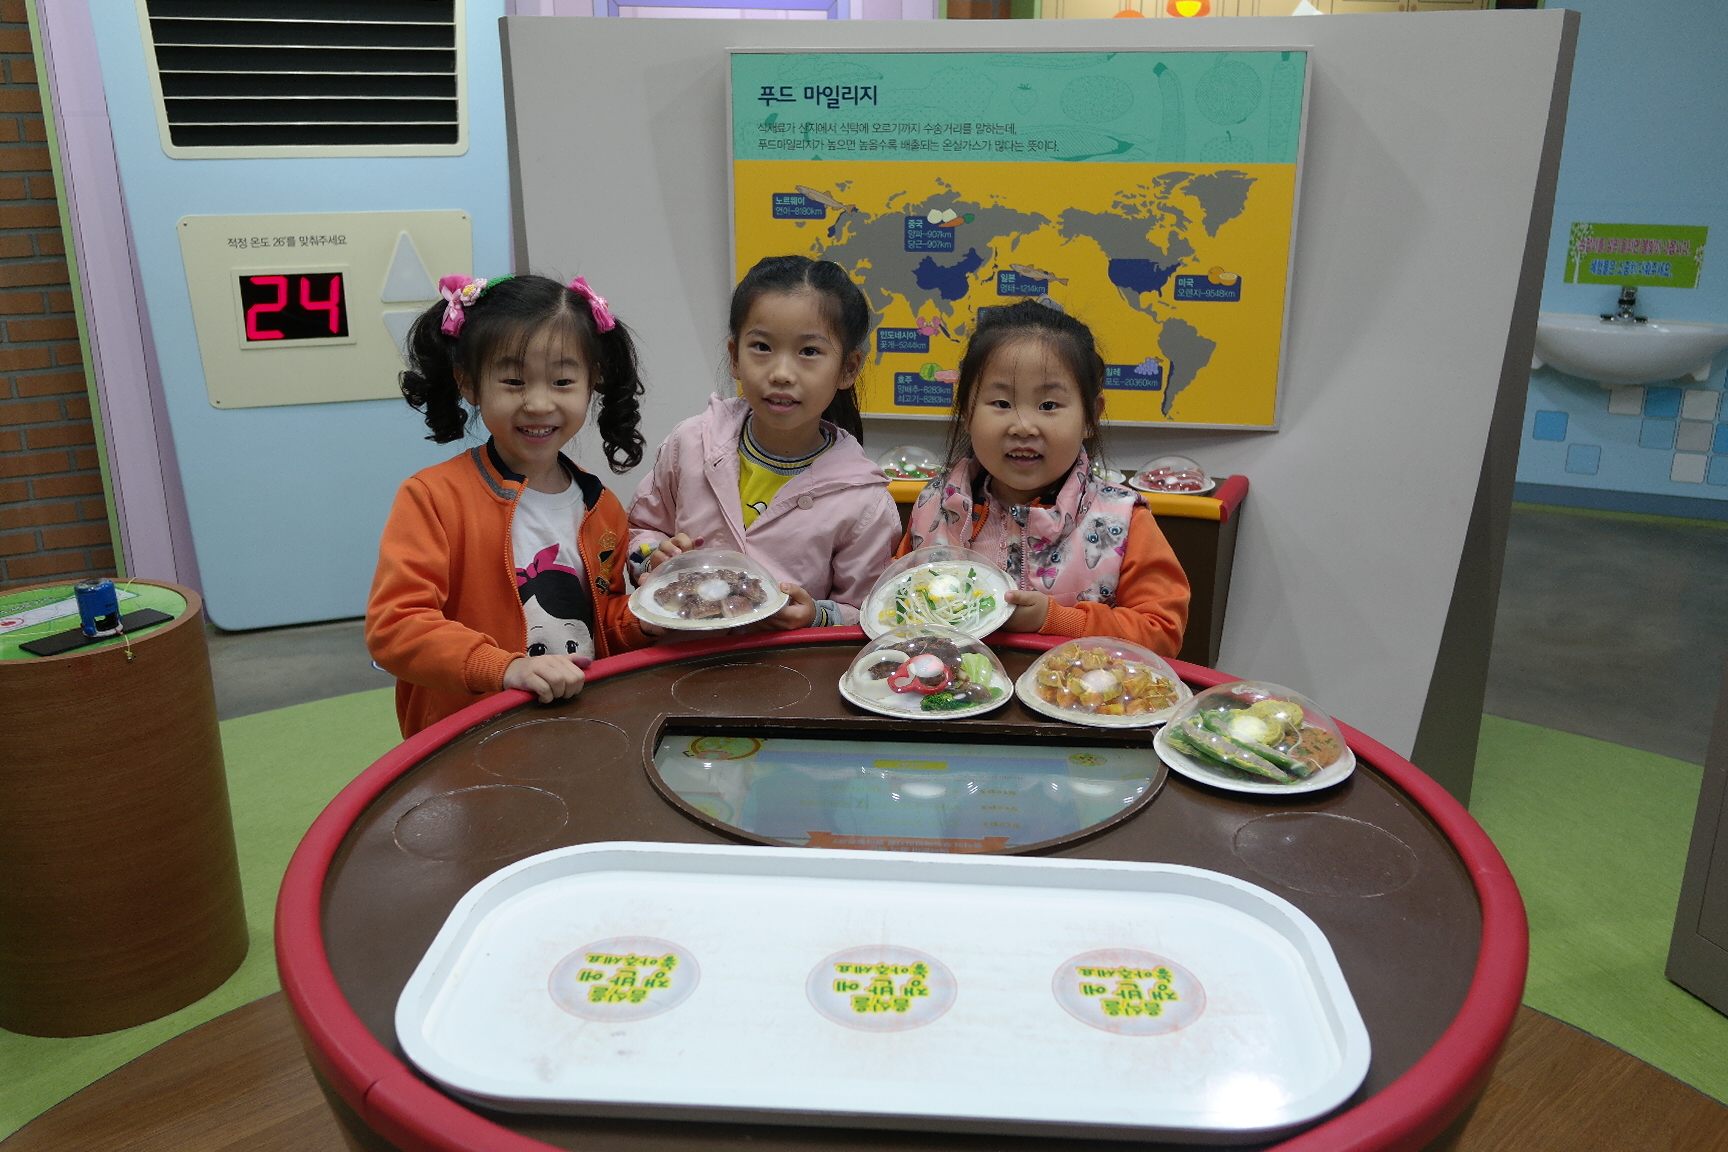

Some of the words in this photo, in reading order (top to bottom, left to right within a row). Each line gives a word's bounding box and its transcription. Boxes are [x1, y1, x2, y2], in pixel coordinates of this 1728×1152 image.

[757, 85, 797, 107] 푸드
[804, 84, 877, 109] 마일리지
[757, 122, 796, 134] 식재료가
[798, 122, 837, 134] 산지에서
[839, 122, 869, 134] 식탁에
[872, 122, 920, 134] 오르기까지
[923, 122, 972, 135] 수송거리를
[757, 138, 824, 151] 푸드마일리지가
[827, 138, 856, 151] 높으면
[900, 138, 939, 152] 배출되는
[942, 138, 992, 152] 온실가스가
[994, 139, 1025, 152] 많다는
[775, 196, 805, 206] 노르웨이
[907, 219, 924, 229] 중국
[907, 229, 952, 239] 양파-907km
[227, 237, 248, 249] 적정
[250, 237, 271, 248] 온도
[299, 234, 347, 247] 맞춰주세요
[907, 239, 952, 249] 당근-907km
[1000, 273, 1016, 283] 일본
[1178, 277, 1195, 288] 미국
[1000, 283, 1046, 294] 명태-1214km
[1177, 288, 1236, 298] 오렌지-9548km
[247, 276, 340, 340] 24
[879, 330, 917, 340] 인도네시아
[879, 340, 927, 350] 꽃게-5244km
[897, 375, 913, 384] 호주
[585, 952, 678, 971] 놓아주세요
[834, 961, 930, 979] 놓아주세요
[1075, 965, 1174, 984] 놓아주세요
[588, 985, 649, 1005] 음식을
[850, 995, 912, 1014] 음식을
[1100, 998, 1163, 1018] 음식을
